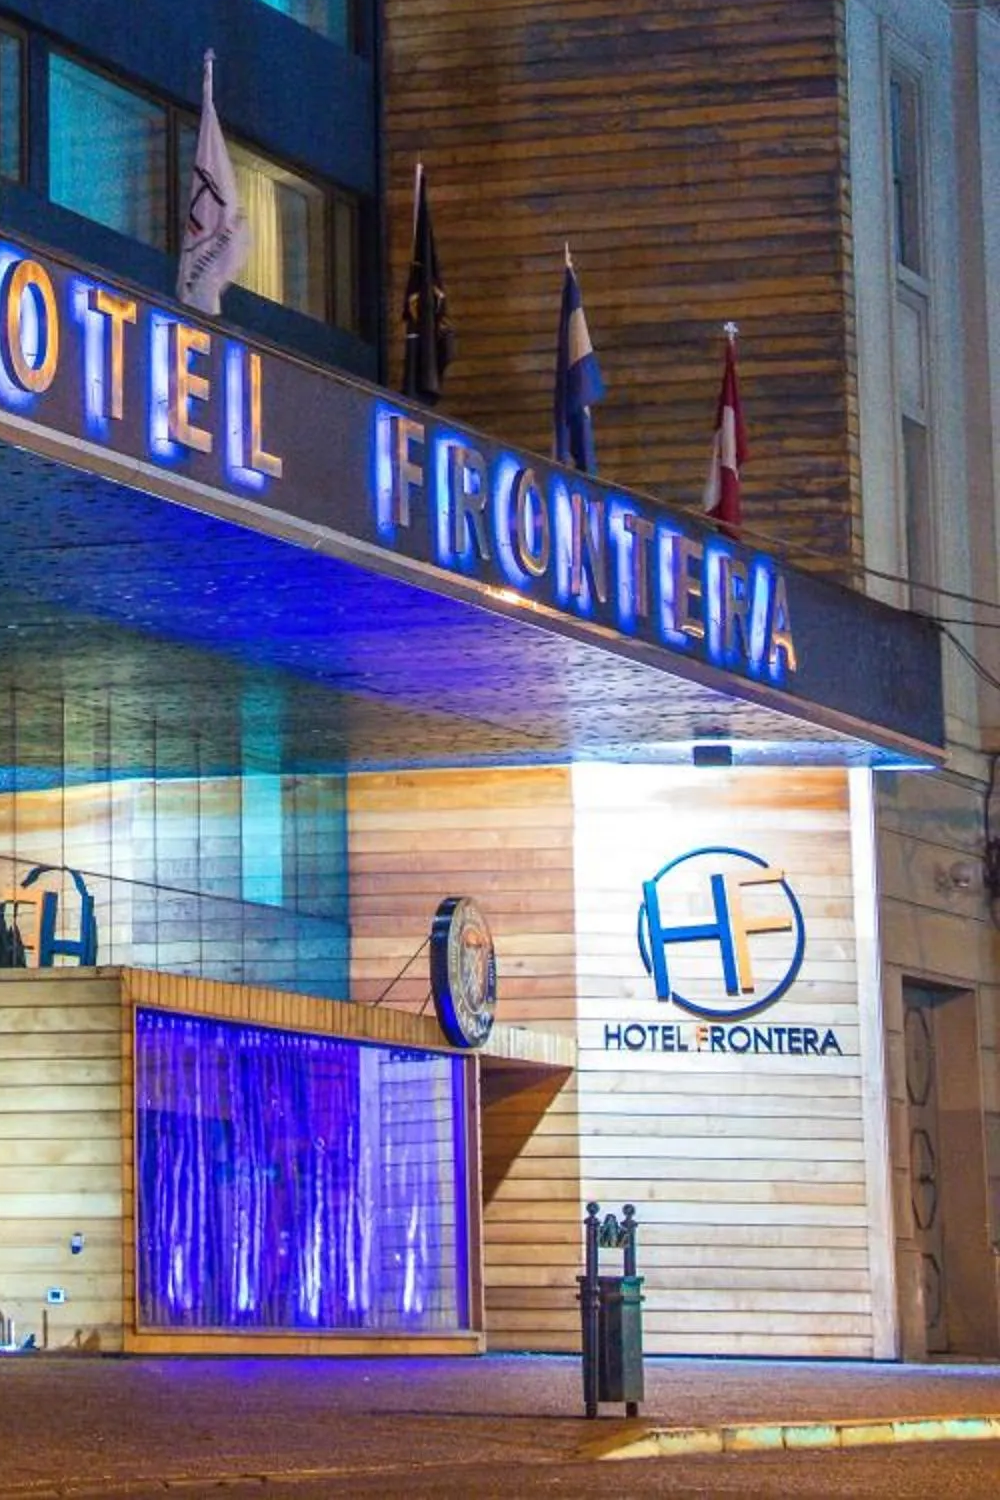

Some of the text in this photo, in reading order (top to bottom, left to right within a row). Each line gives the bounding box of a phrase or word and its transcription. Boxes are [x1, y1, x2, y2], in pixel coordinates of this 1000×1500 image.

[374, 406, 798, 674] FRONTERA
[604, 1024, 842, 1056] HOTEL FRONTERA
